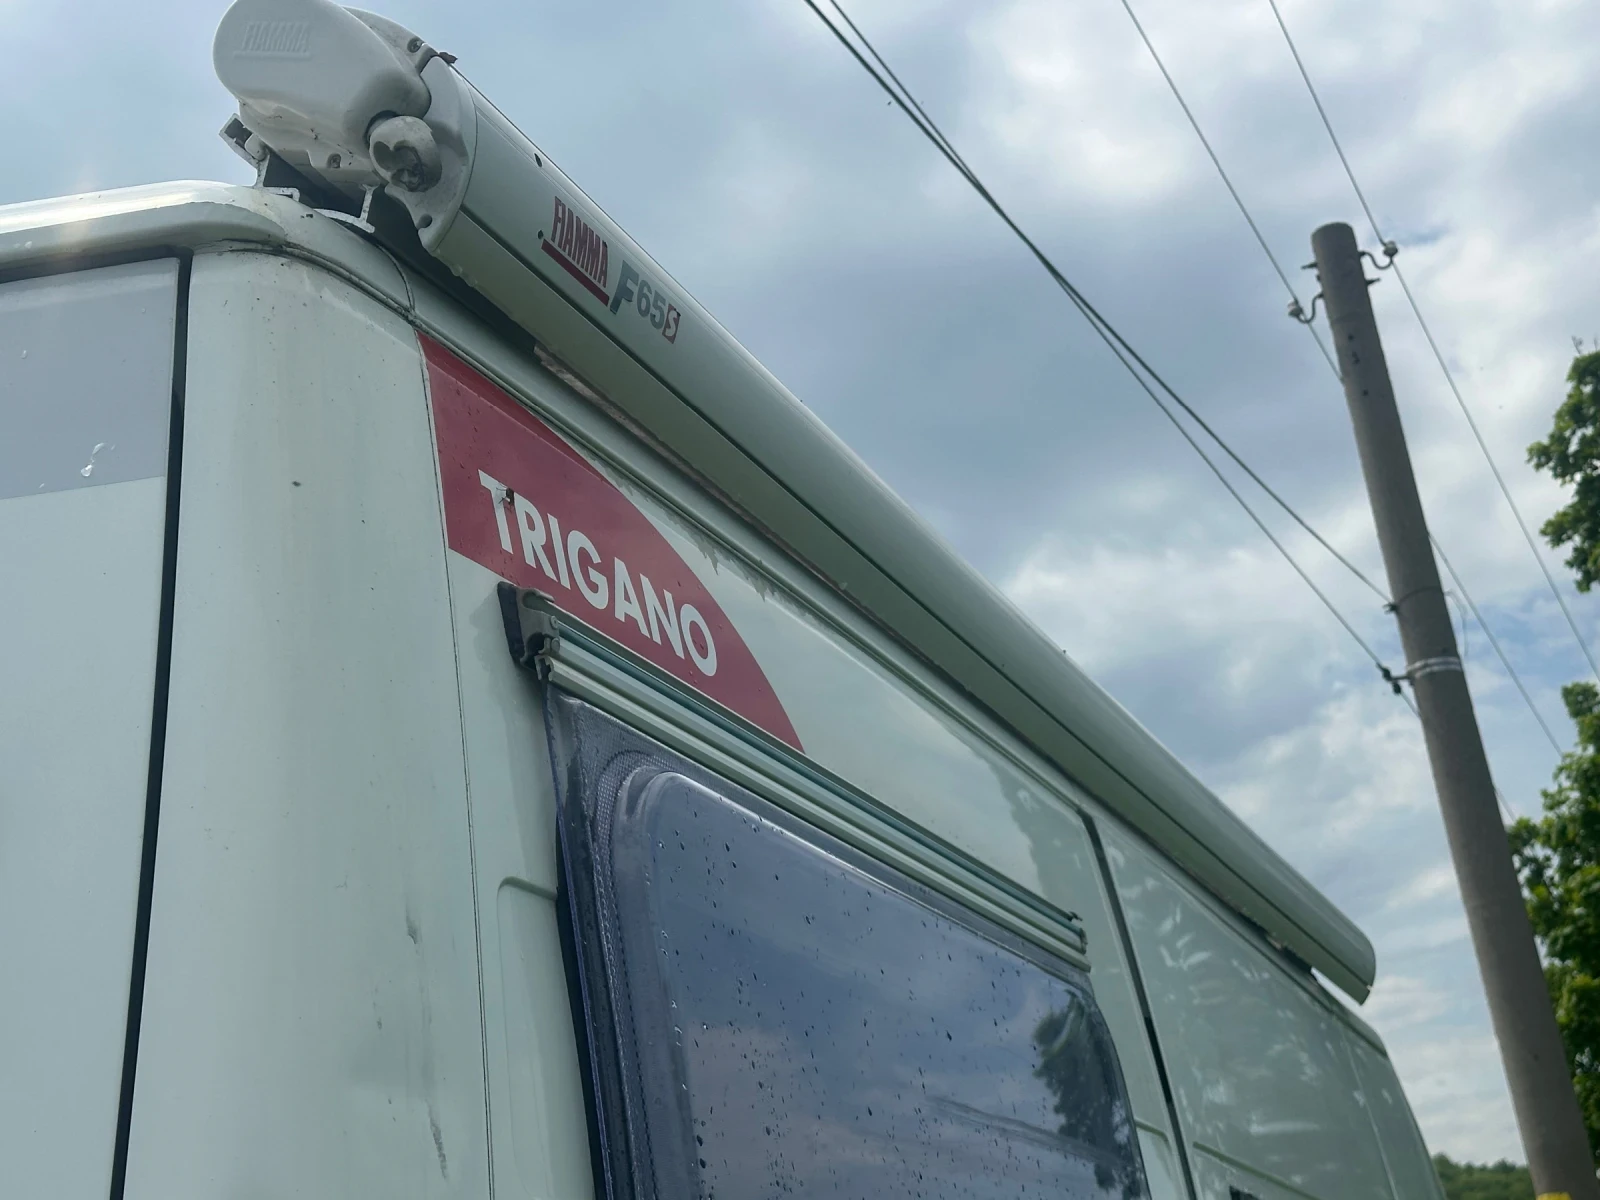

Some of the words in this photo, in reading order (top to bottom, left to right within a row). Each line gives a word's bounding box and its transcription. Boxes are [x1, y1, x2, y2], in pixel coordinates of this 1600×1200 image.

[241, 21, 311, 52] FIAMMA
[551, 195, 608, 288] FIAMMA
[609, 260, 681, 344] F65S
[478, 469, 717, 676] TRIGANO
